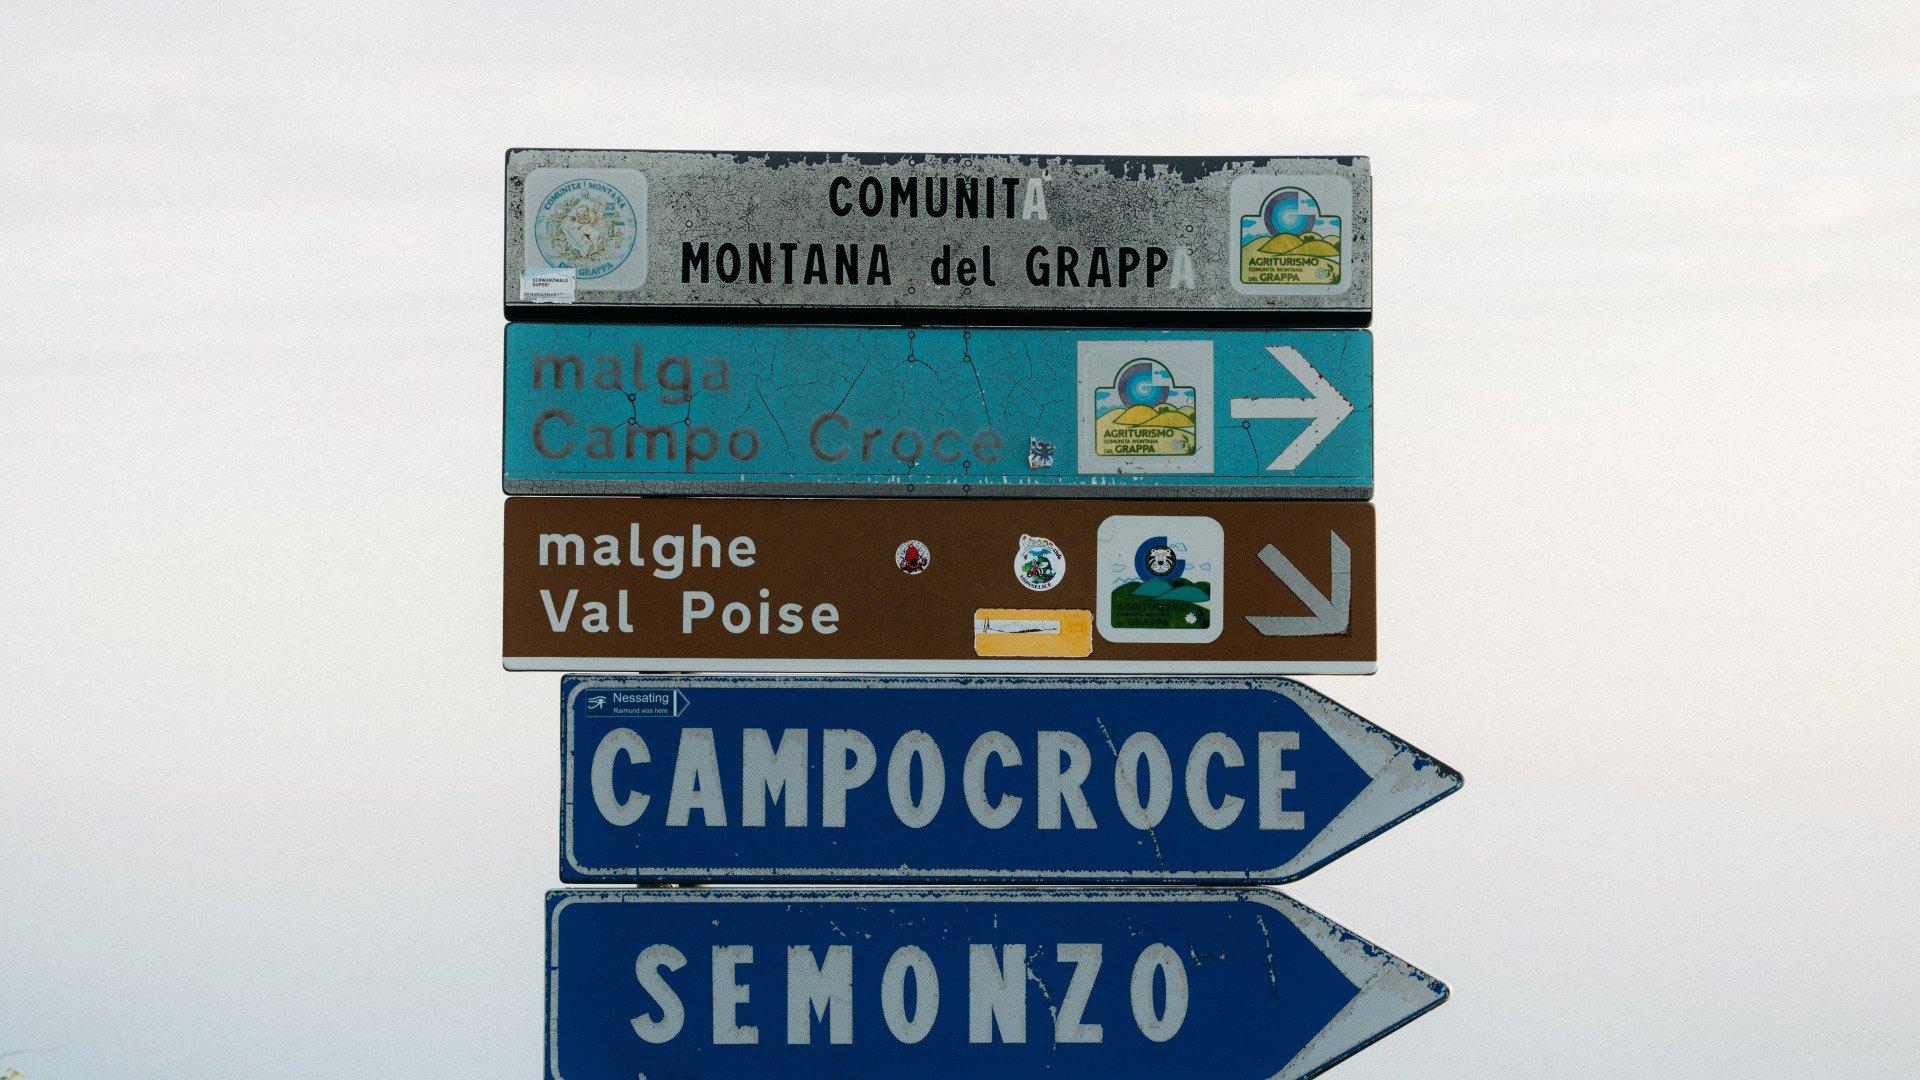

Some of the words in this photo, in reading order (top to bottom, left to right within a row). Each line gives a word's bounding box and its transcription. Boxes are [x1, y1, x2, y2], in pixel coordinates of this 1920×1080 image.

[588, 182, 626, 209] MONTANA
[579, 262, 613, 276] GRAPPA
[681, 242, 892, 286] MONTANA
[930, 245, 996, 287] del
[1025, 245, 1195, 289] GRAPPA
[1248, 257, 1320, 267] AGRITURISMO
[1260, 273, 1301, 282] GRAPPA
[532, 342, 731, 405] malga
[532, 407, 761, 473] Campo
[809, 412, 1004, 463] Croce
[1103, 429, 1175, 438] AGRITURISMO
[1115, 444, 1155, 454] GRAPPA
[539, 522, 757, 579] malghe
[539, 589, 634, 633] Val
[682, 588, 840, 635] Poise
[613, 692, 669, 705] Nessating
[590, 727, 1306, 831] CAMPOCROCE
[629, 942, 1190, 1046] SEMONZO
